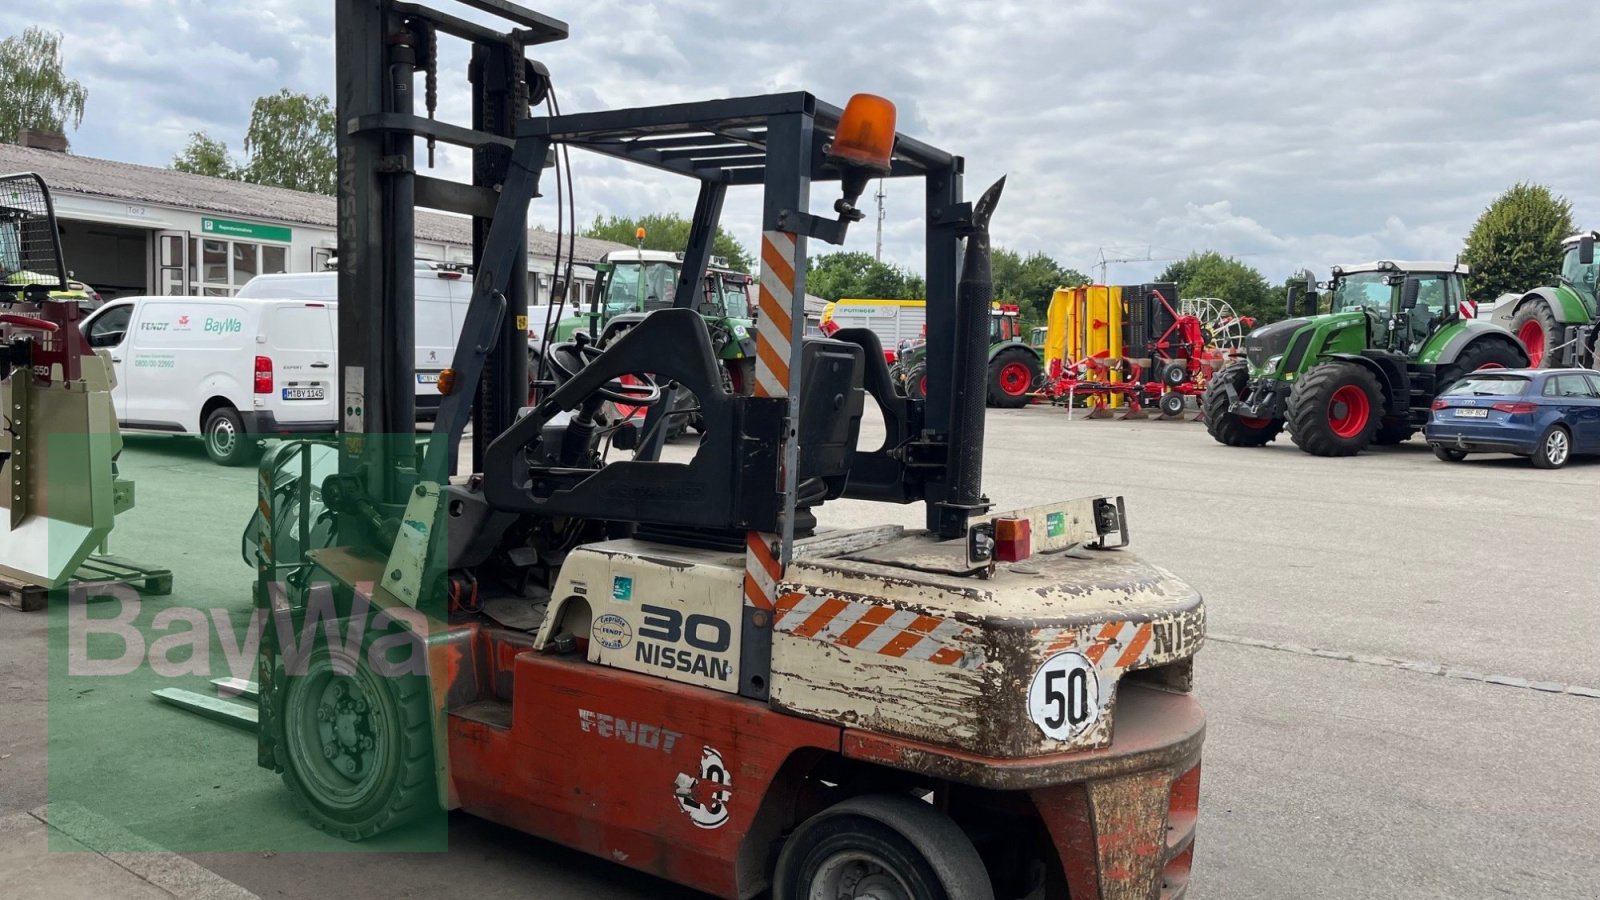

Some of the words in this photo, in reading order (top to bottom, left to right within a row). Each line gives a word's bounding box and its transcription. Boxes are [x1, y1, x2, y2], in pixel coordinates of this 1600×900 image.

[128, 206, 139, 214] Tor
[141, 207, 145, 215] 2
[140, 322, 169, 331] FENDT
[204, 318, 242, 335] BayWa
[307, 390, 324, 398] 1145
[602, 627, 622, 636] FENDT
[638, 603, 731, 653] 30
[635, 641, 729, 682] NISSAN
[1044, 667, 1088, 730] 50
[578, 708, 683, 754] FENDT
